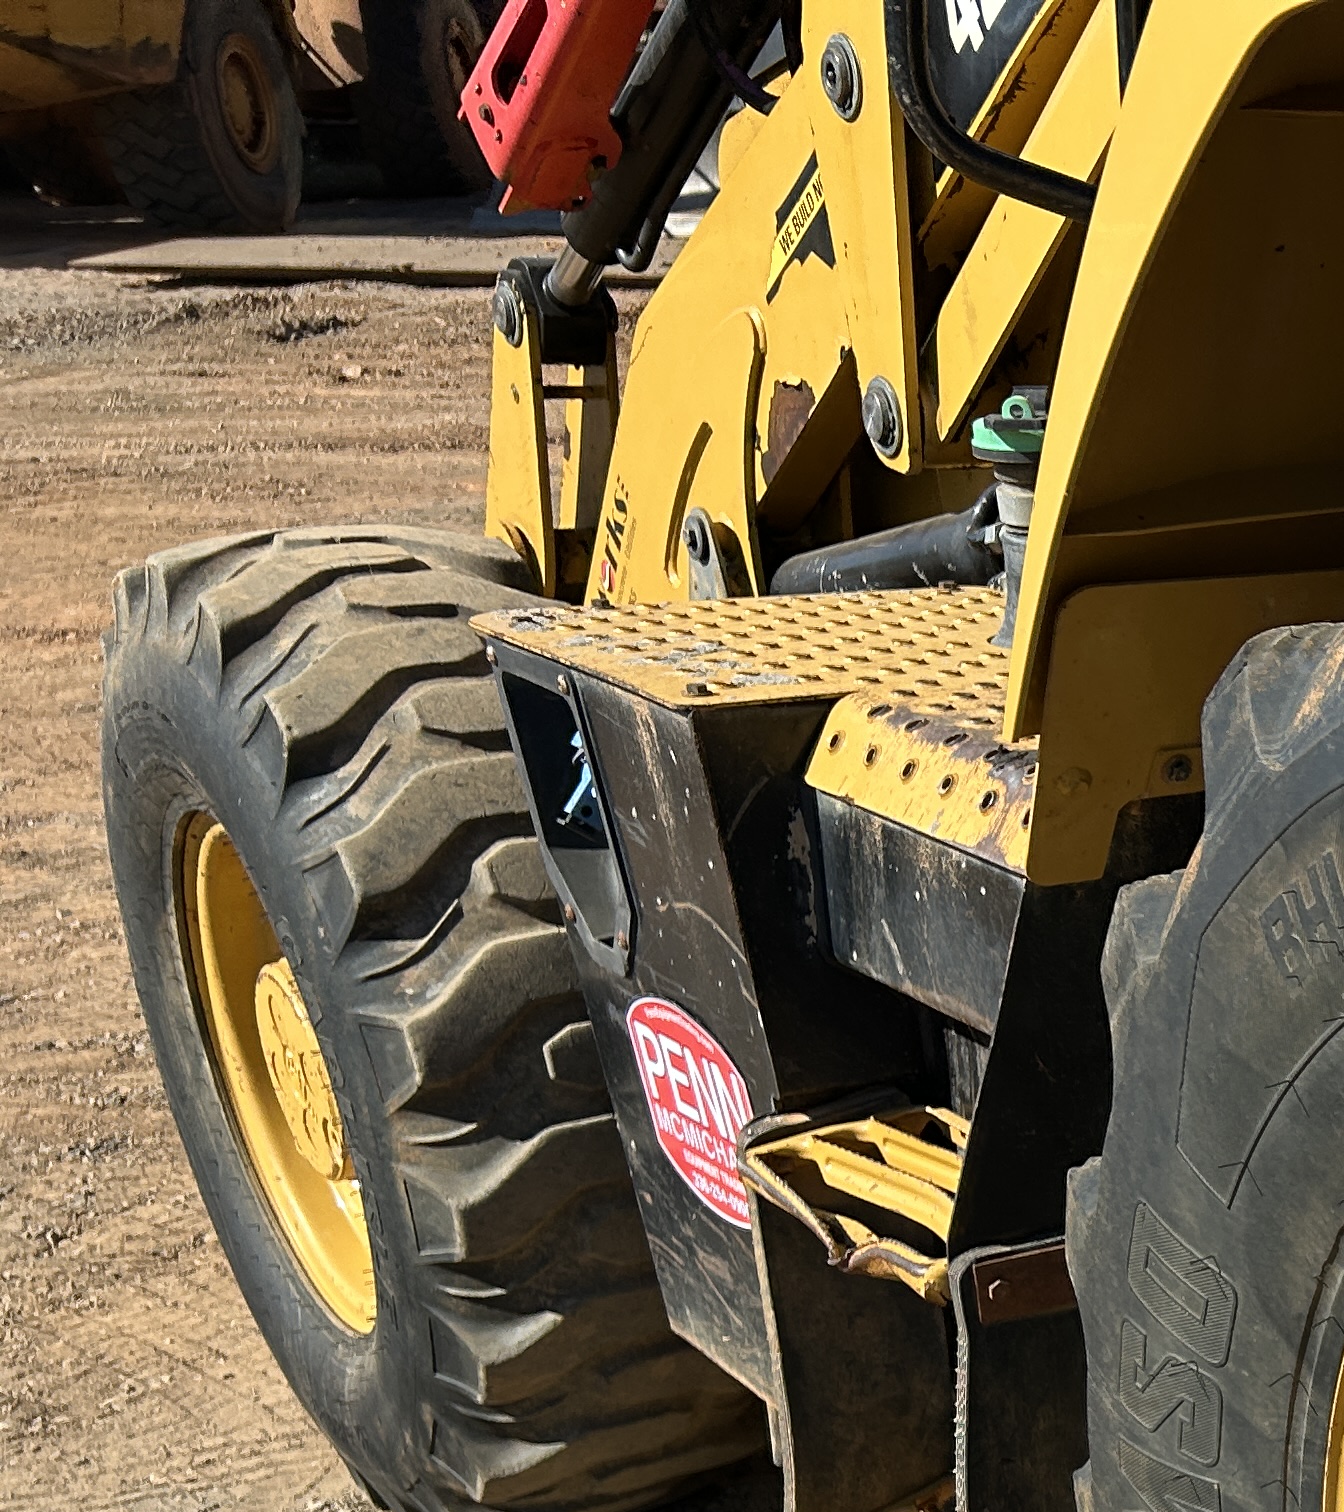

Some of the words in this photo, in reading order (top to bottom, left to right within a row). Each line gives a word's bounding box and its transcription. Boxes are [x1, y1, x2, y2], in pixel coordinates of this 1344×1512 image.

[779, 224, 795, 256] WE
[792, 191, 815, 237] BUILD
[633, 1018, 749, 1145] PENN
